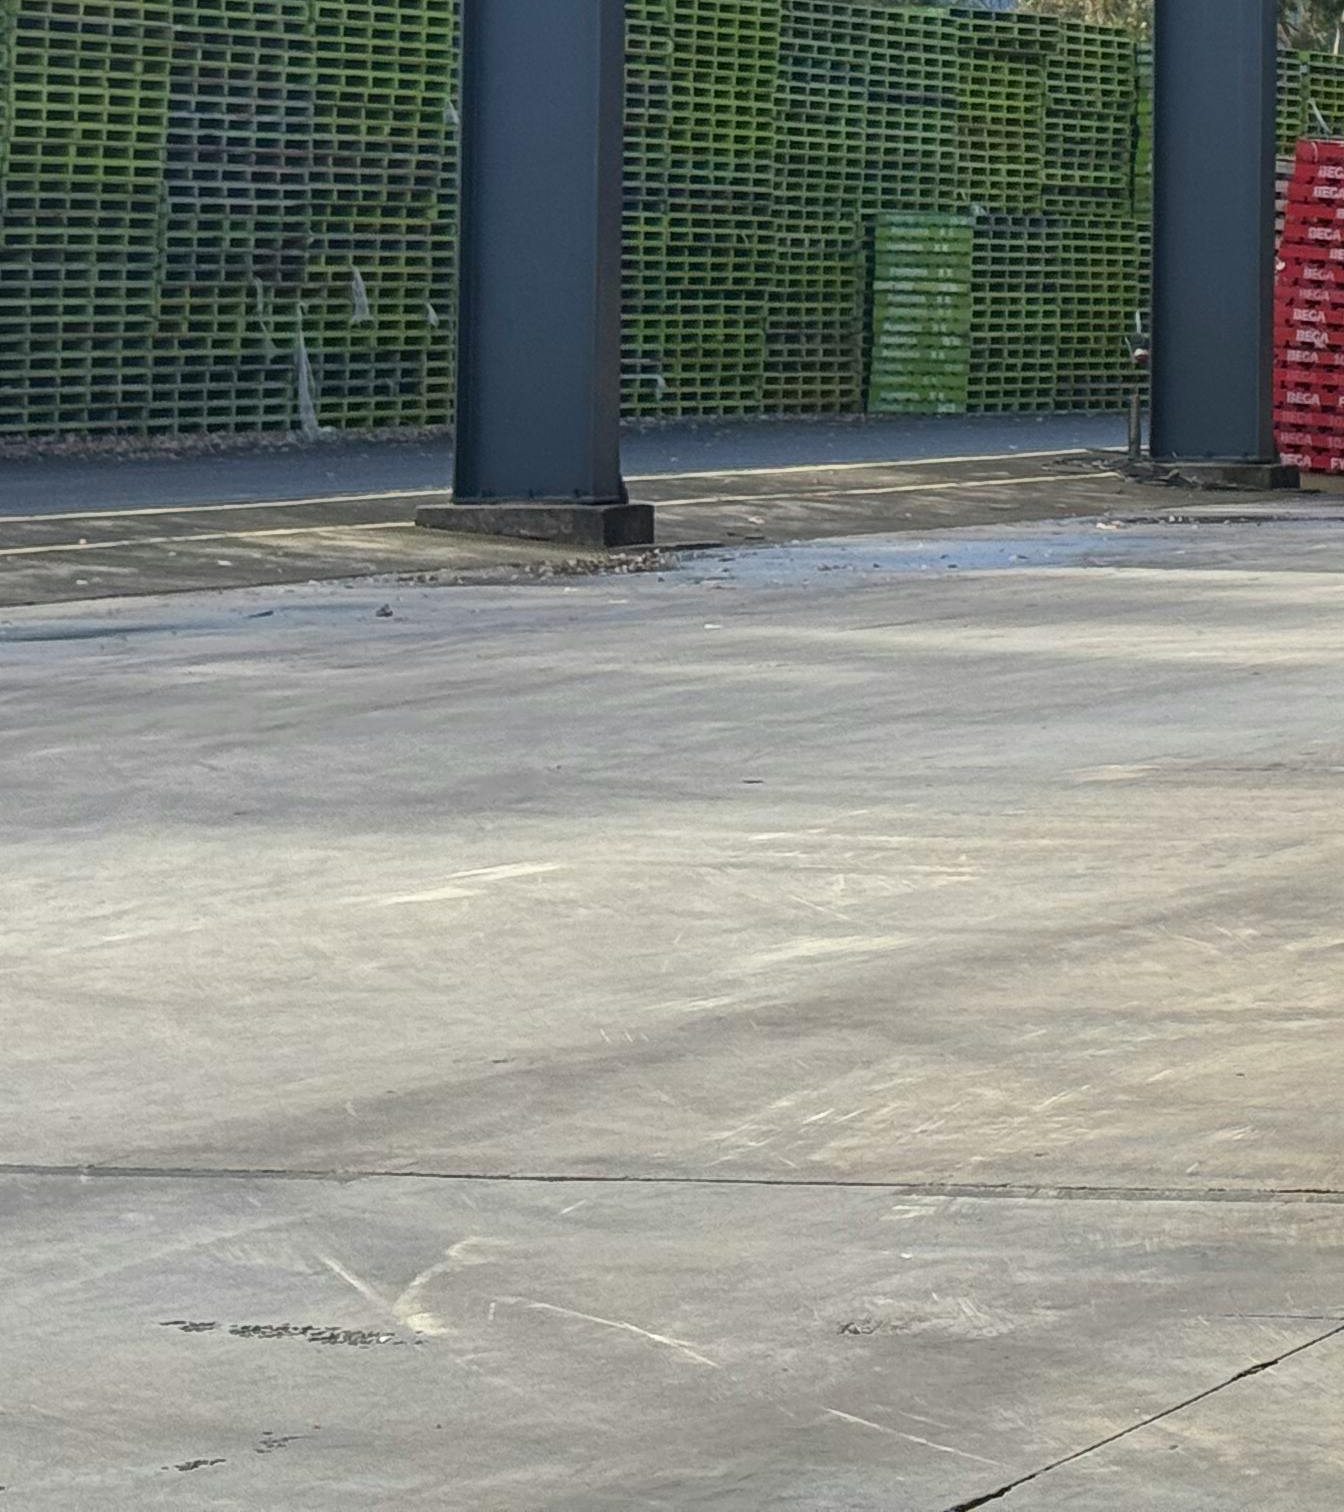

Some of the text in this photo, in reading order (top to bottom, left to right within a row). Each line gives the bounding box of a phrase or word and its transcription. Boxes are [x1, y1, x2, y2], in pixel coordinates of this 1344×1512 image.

[1308, 227, 1340, 241] BEGA
[1304, 268, 1335, 281] BEGA
[1293, 308, 1326, 323] BEGA
[1296, 329, 1329, 344] BEGA
[1287, 350, 1319, 363] BEGA
[1287, 392, 1320, 406] BEGA
[1280, 432, 1313, 446] BEGA
